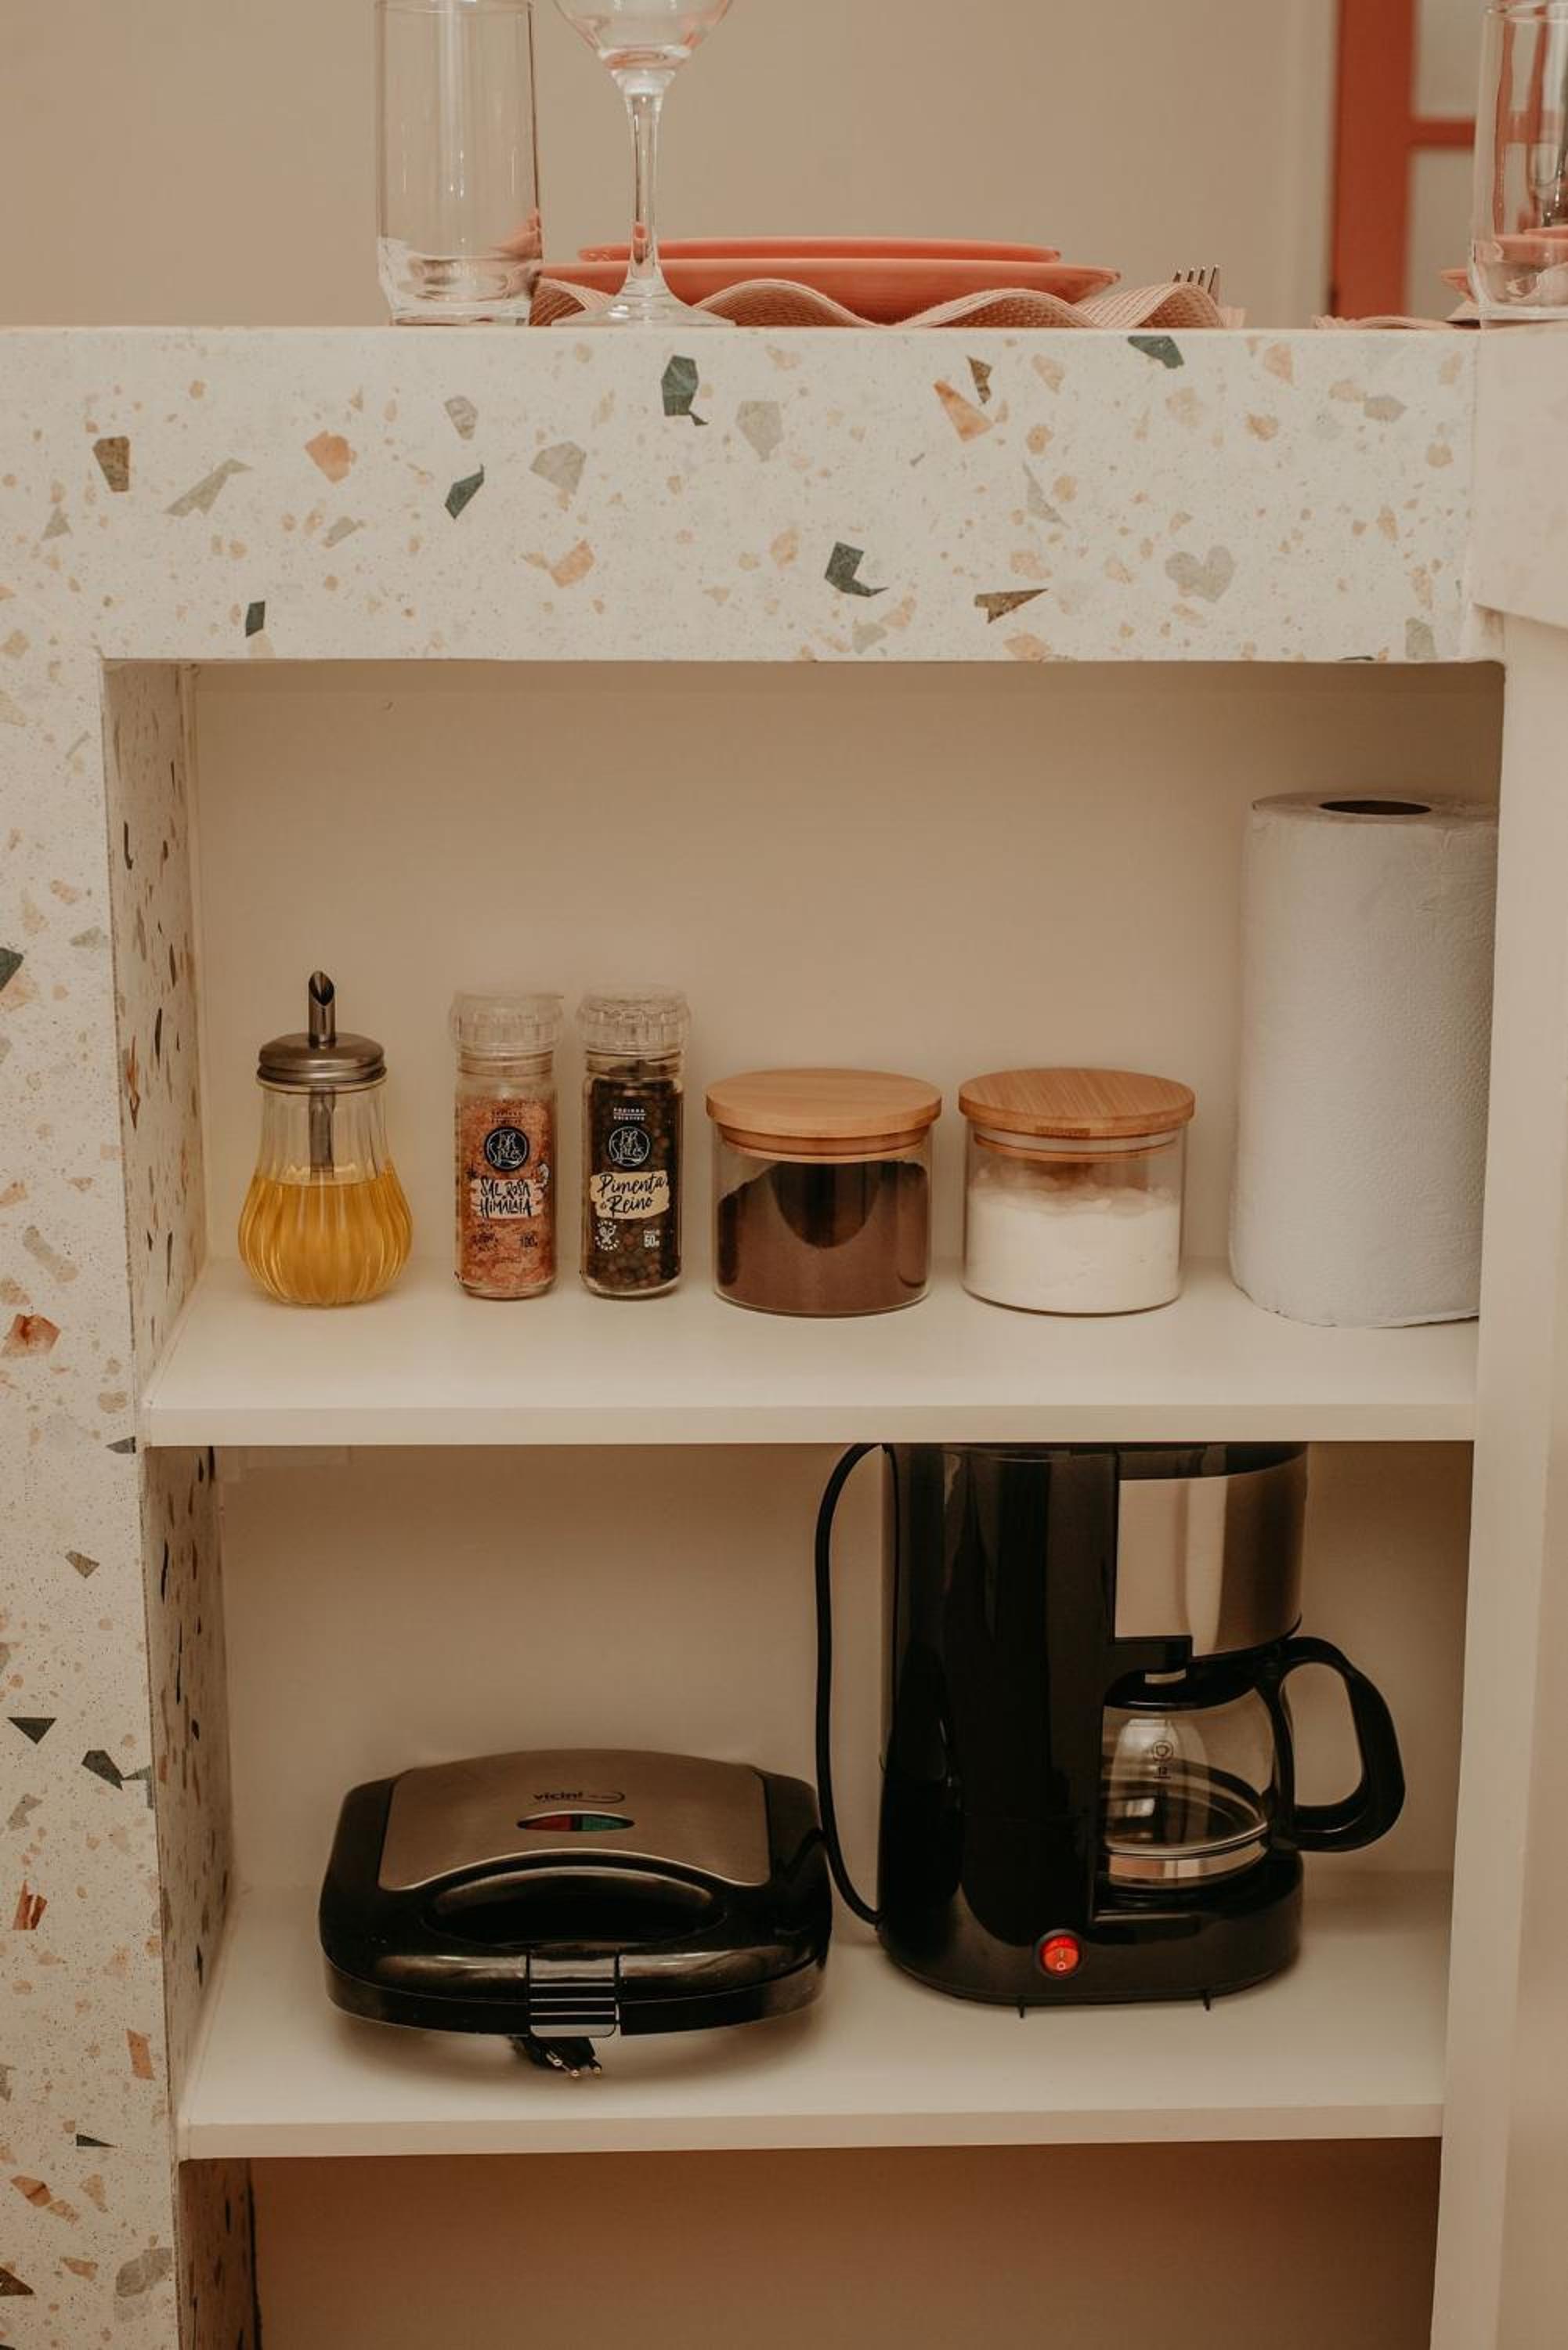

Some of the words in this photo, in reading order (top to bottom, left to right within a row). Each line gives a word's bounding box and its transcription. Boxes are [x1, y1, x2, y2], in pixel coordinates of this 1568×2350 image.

[480, 1176, 502, 1198] SAL
[505, 1178, 531, 1199] ROSA
[597, 1173, 667, 1197] Pimenta
[606, 1195, 654, 1217] Reino
